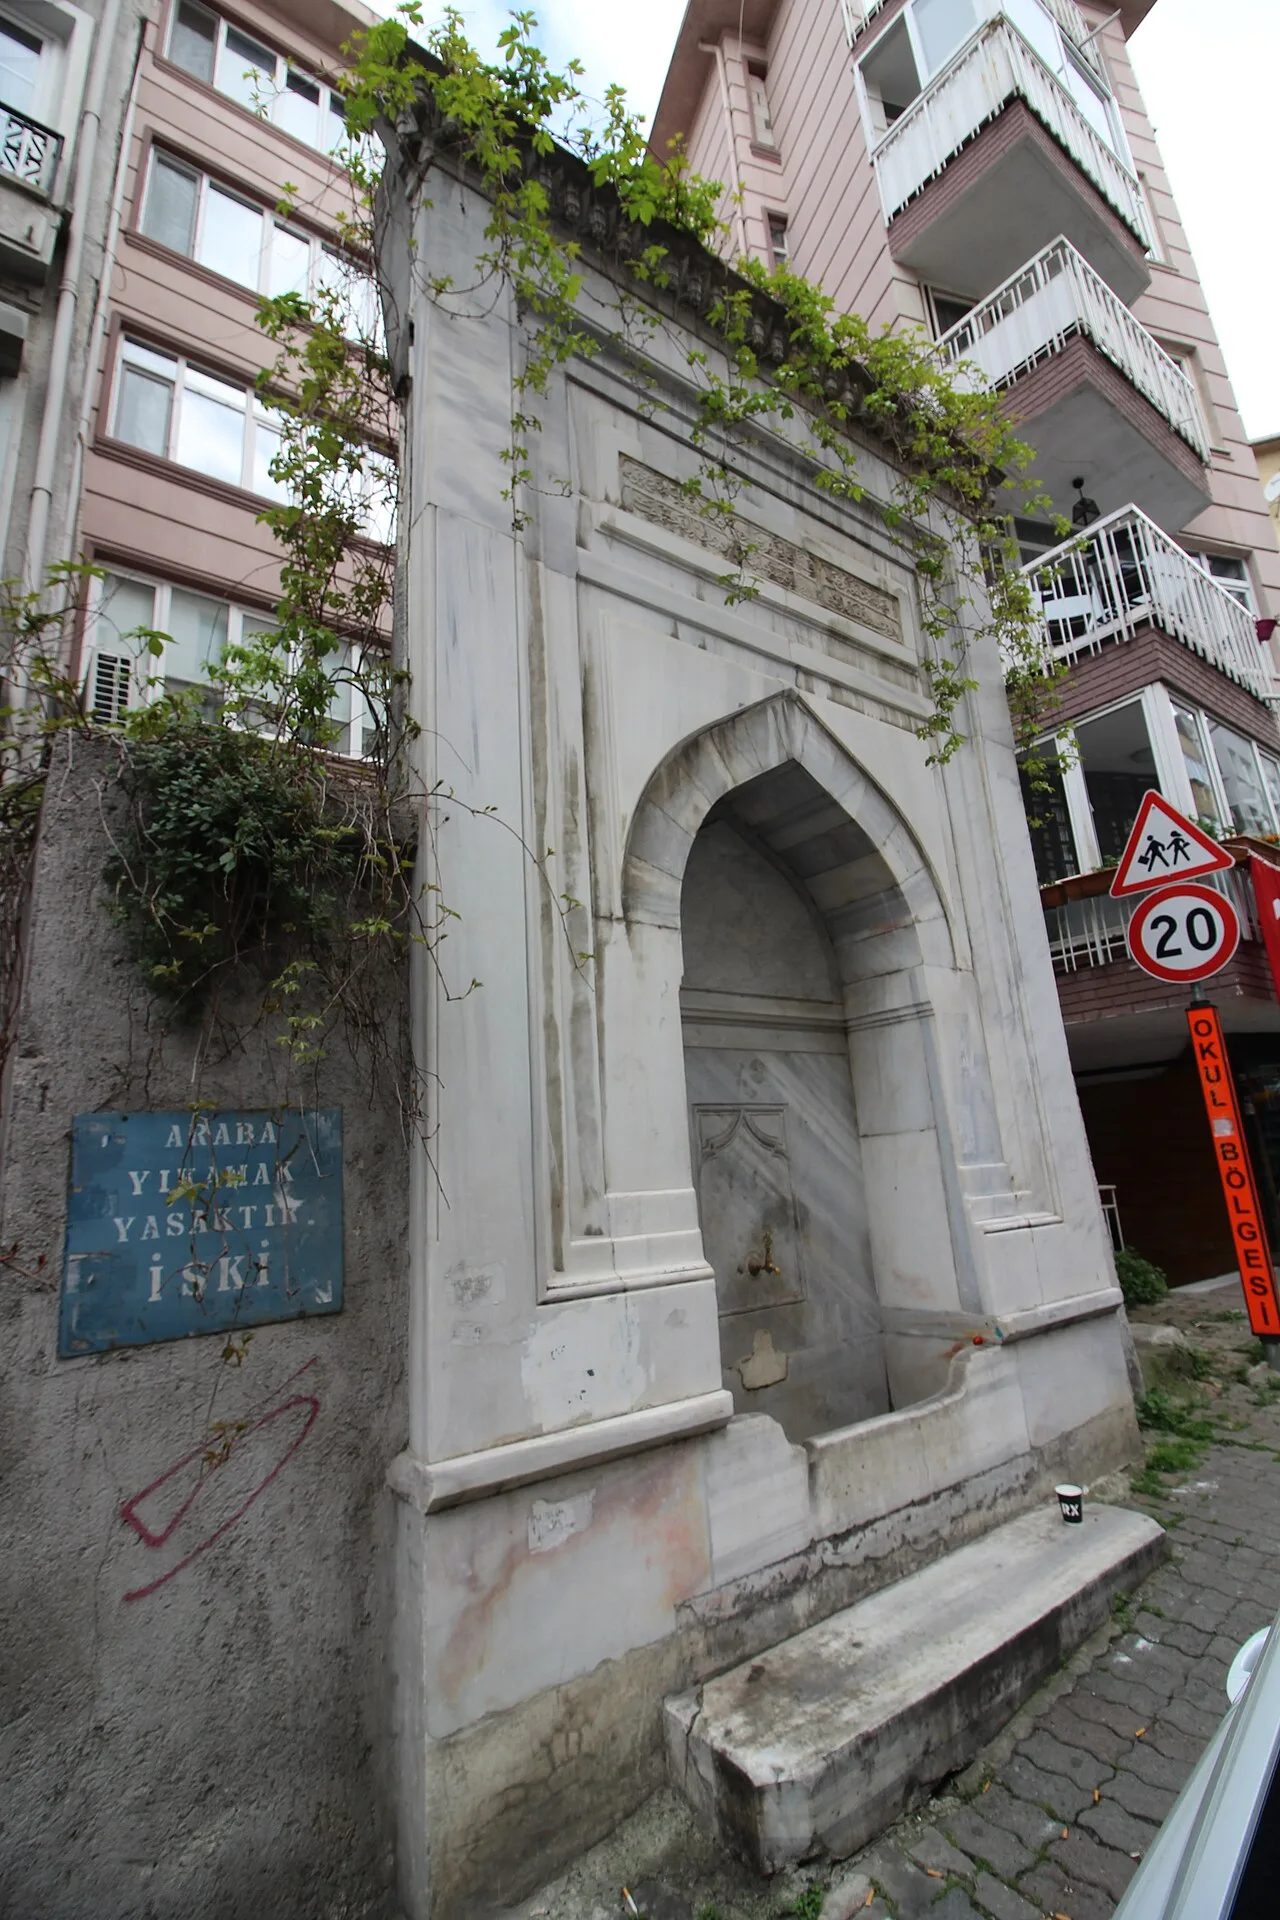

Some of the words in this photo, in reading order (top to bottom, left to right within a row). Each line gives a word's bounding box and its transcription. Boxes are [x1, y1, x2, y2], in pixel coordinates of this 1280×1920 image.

[1150, 907, 1217, 959] 20
[1194, 1019, 1227, 1107] OKUL
[165, 1121, 277, 1148] ARABA
[148, 1239, 271, 1302] İSKİ
